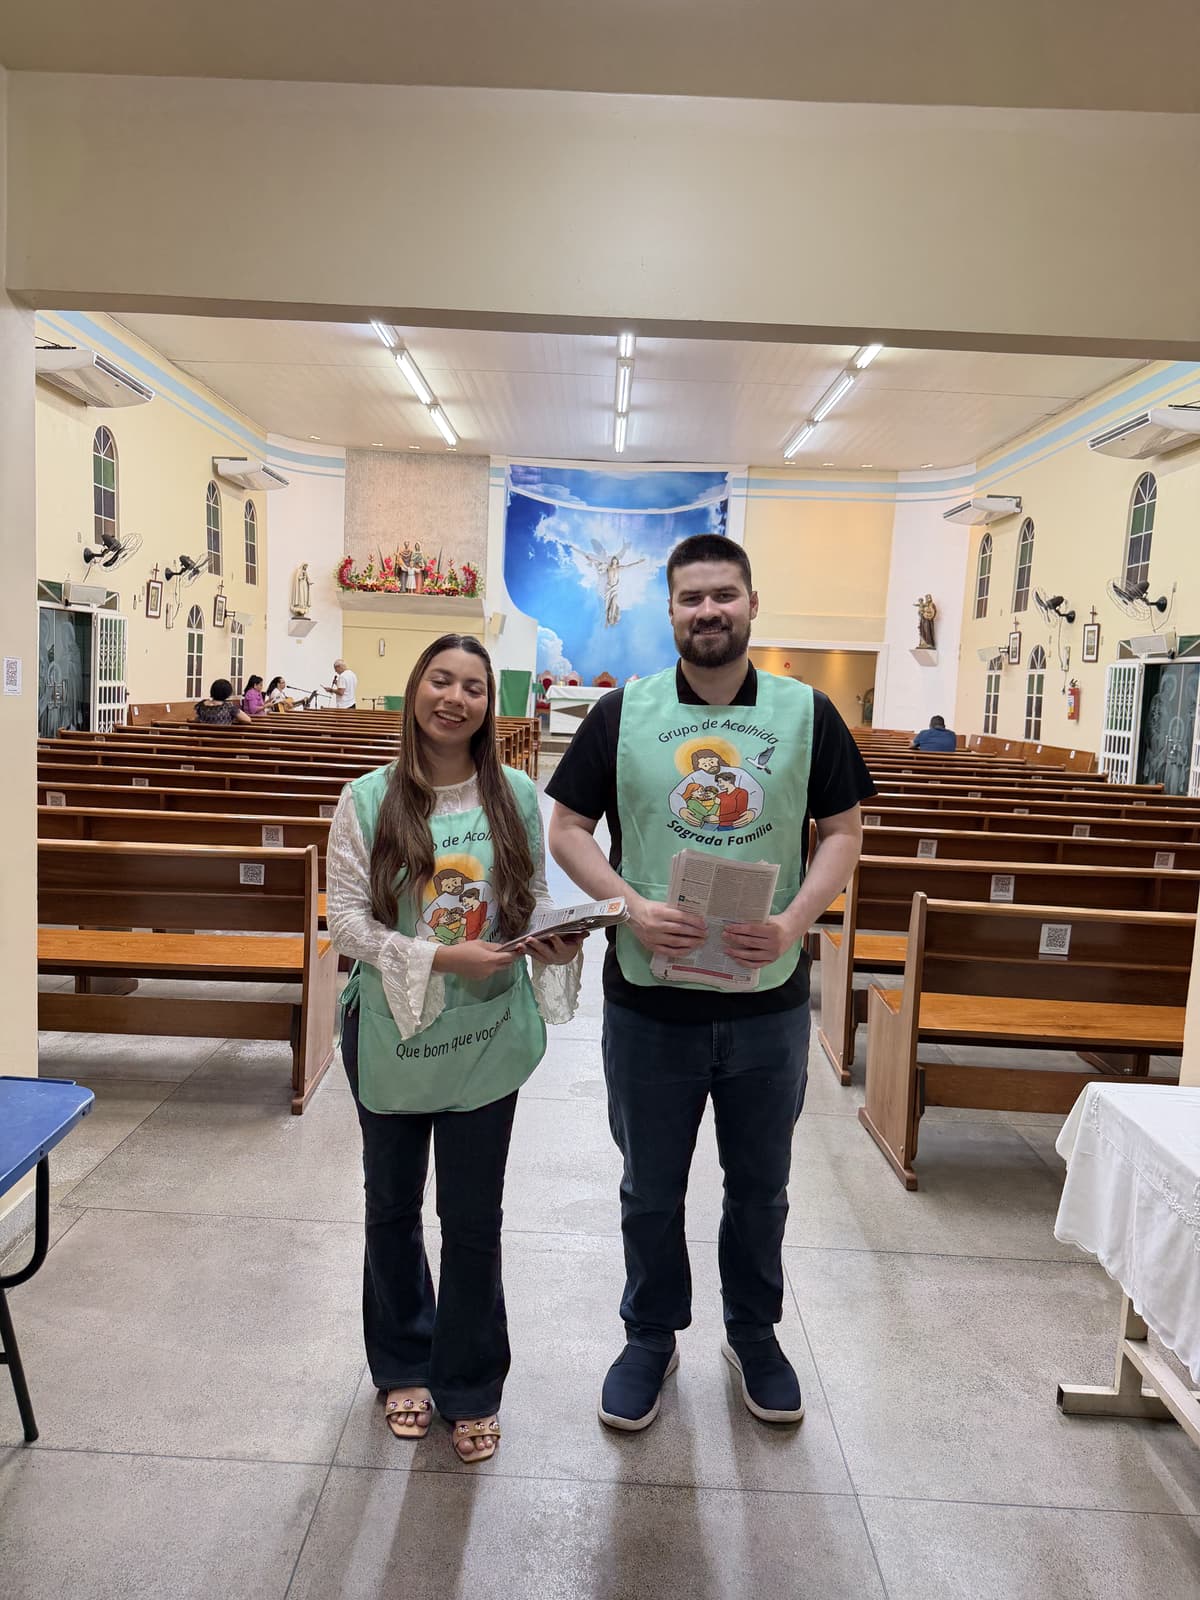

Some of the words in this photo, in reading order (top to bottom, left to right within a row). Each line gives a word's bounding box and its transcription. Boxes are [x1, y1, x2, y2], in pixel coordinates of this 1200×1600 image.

[658, 724, 698, 743] Grupo
[702, 719, 718, 730] de
[721, 719, 779, 745] Acolhida
[442, 836, 459, 848] de
[462, 830, 493, 844] Acol
[667, 820, 723, 846] Sagrada
[727, 822, 773, 846] Família
[396, 1043, 420, 1060] Que
[423, 1042, 449, 1058] bom
[451, 1033, 473, 1052] que
[475, 1021, 499, 1042] voc
